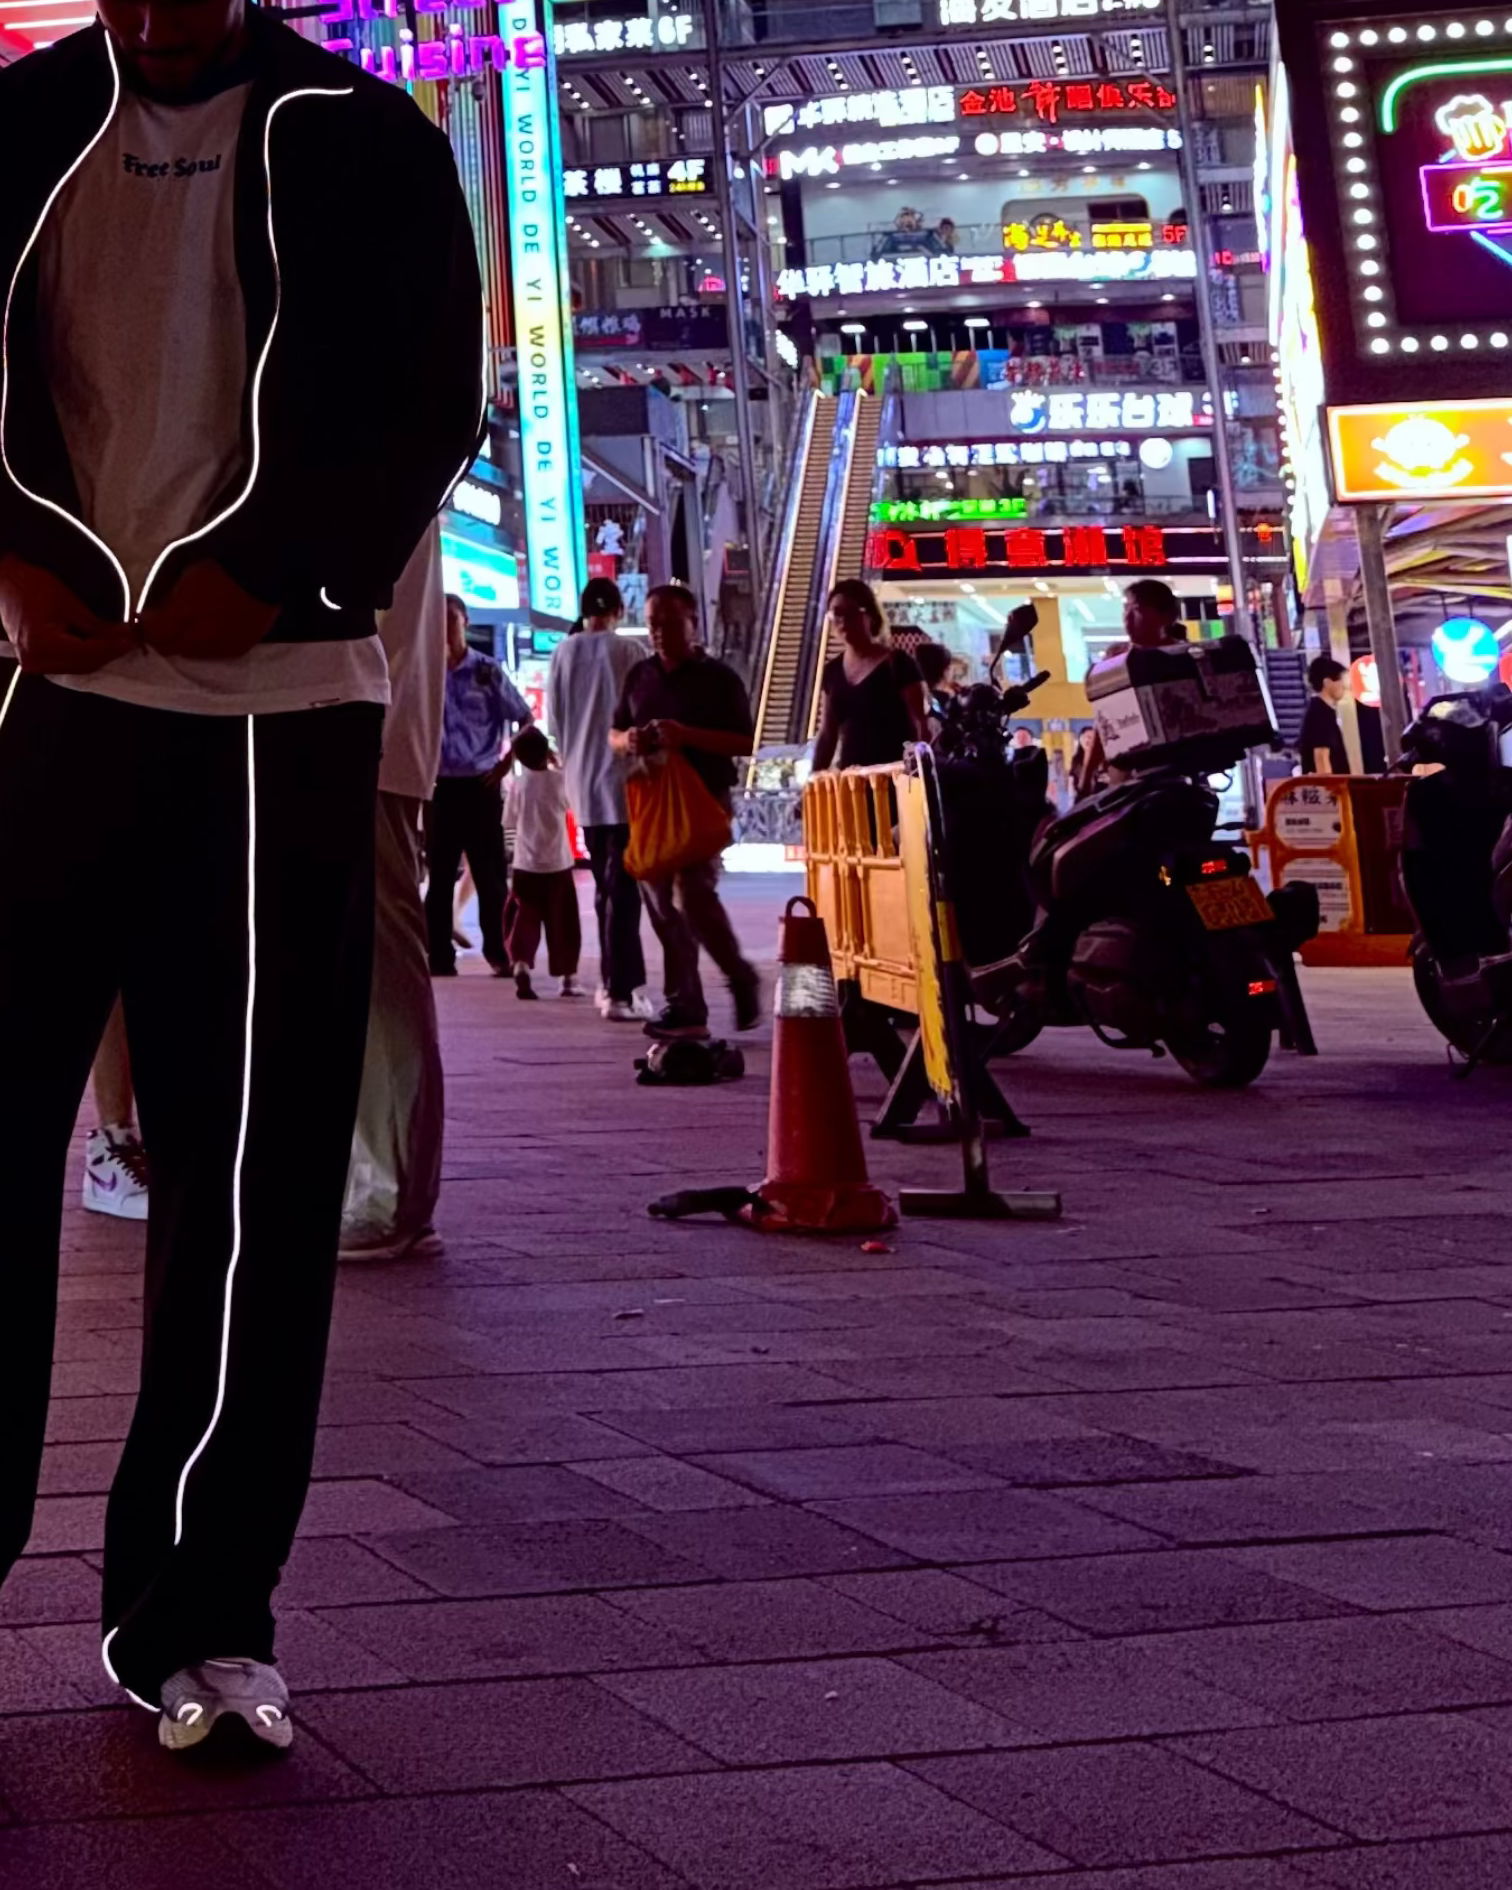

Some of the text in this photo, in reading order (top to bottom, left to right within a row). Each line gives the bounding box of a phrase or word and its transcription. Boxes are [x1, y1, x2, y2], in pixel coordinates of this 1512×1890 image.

[123, 153, 222, 178] Free Soul
[517, 113, 537, 203] WORLD
[668, 159, 706, 182] 4F
[522, 223, 541, 254] DE
[526, 278, 542, 303] YI
[529, 324, 549, 419] WORLD
[536, 440, 552, 471] DE
[541, 496, 557, 522] YI
